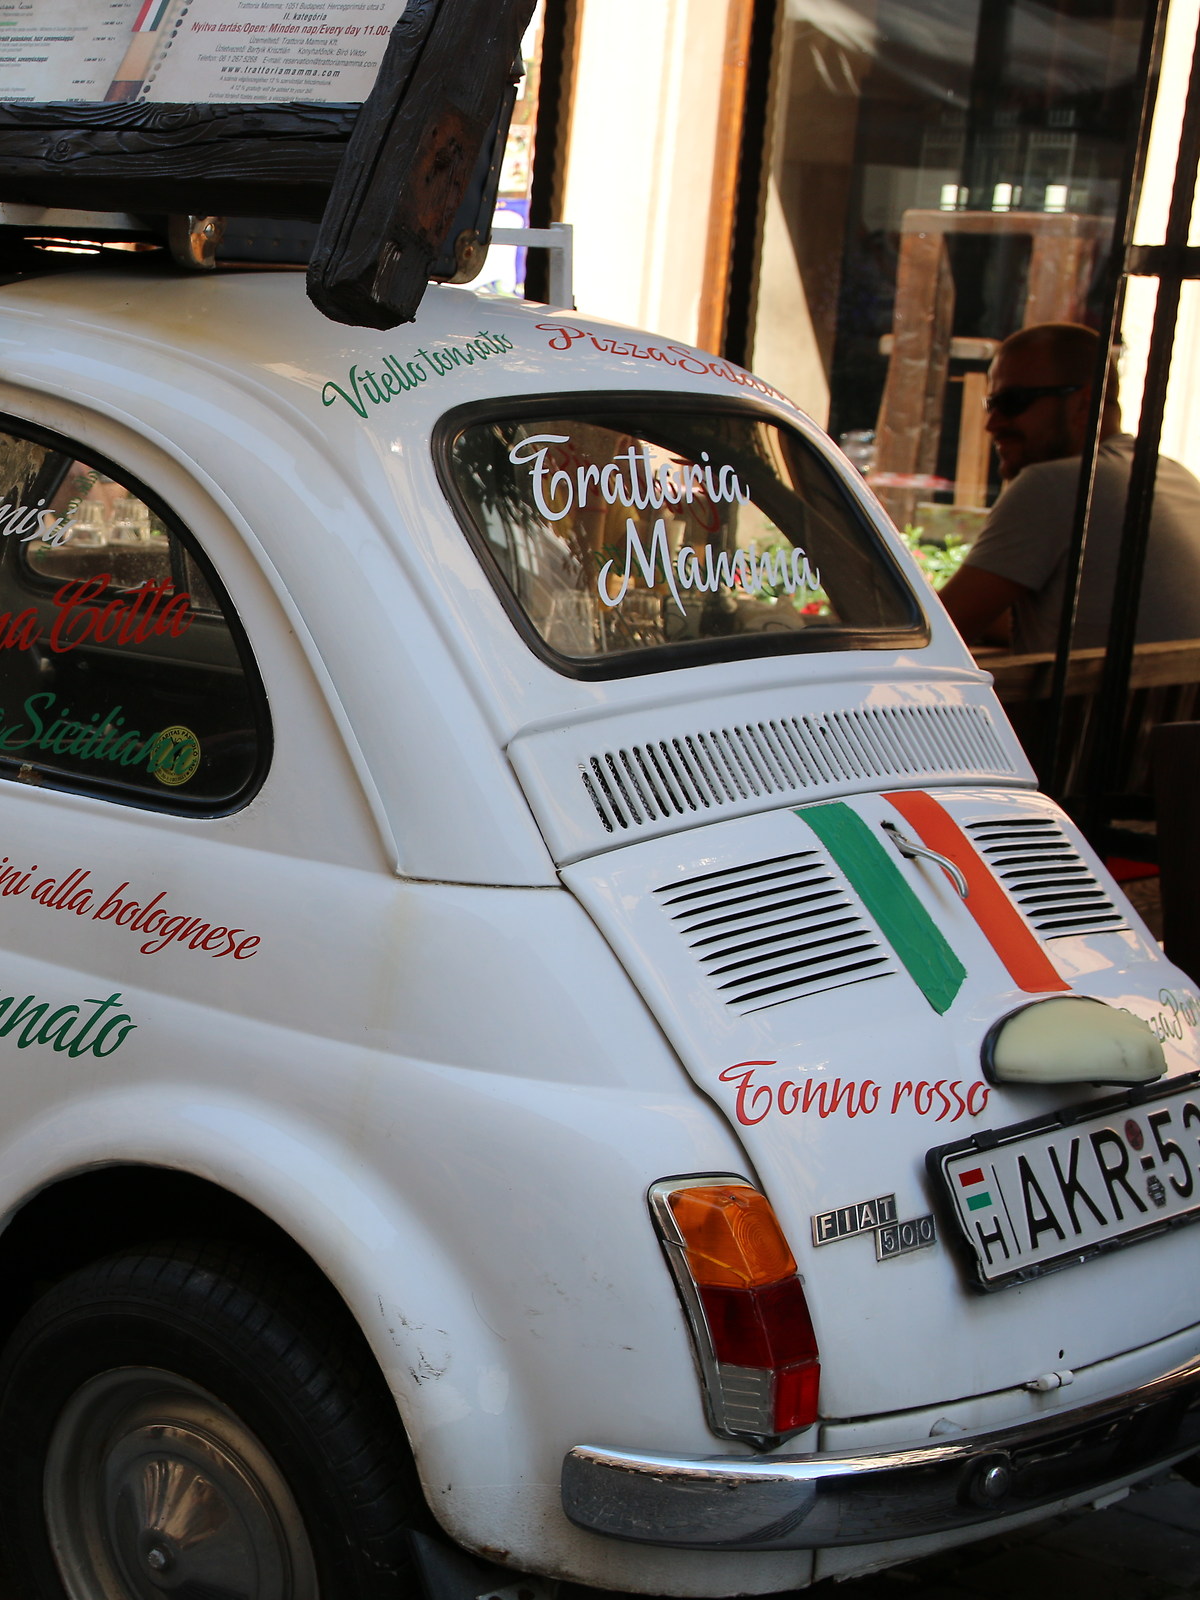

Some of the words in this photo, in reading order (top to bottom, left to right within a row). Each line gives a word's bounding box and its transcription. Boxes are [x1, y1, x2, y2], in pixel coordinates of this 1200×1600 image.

[191, 21, 217, 33] Nyitva
[268, 23, 300, 34] Minden
[345, 25, 361, 37] day
[221, 66, 341, 77] www.trattoriamamma.com
[322, 354, 427, 419] Vitello
[414, 330, 514, 377] tonnato
[535, 323, 677, 366] Pizza
[508, 434, 750, 521] Trattoria
[597, 518, 821, 617] Mamma
[50, 573, 197, 655] Cotta
[0, 692, 197, 775] Siciliana
[30, 868, 94, 917] alla
[92, 881, 262, 962] bolognese
[718, 1060, 882, 1127] Tonno
[890, 1079, 993, 1123] rosso
[818, 1198, 897, 1242] FIAT
[882, 1218, 934, 1253] 500
[975, 1215, 1011, 1265] H
